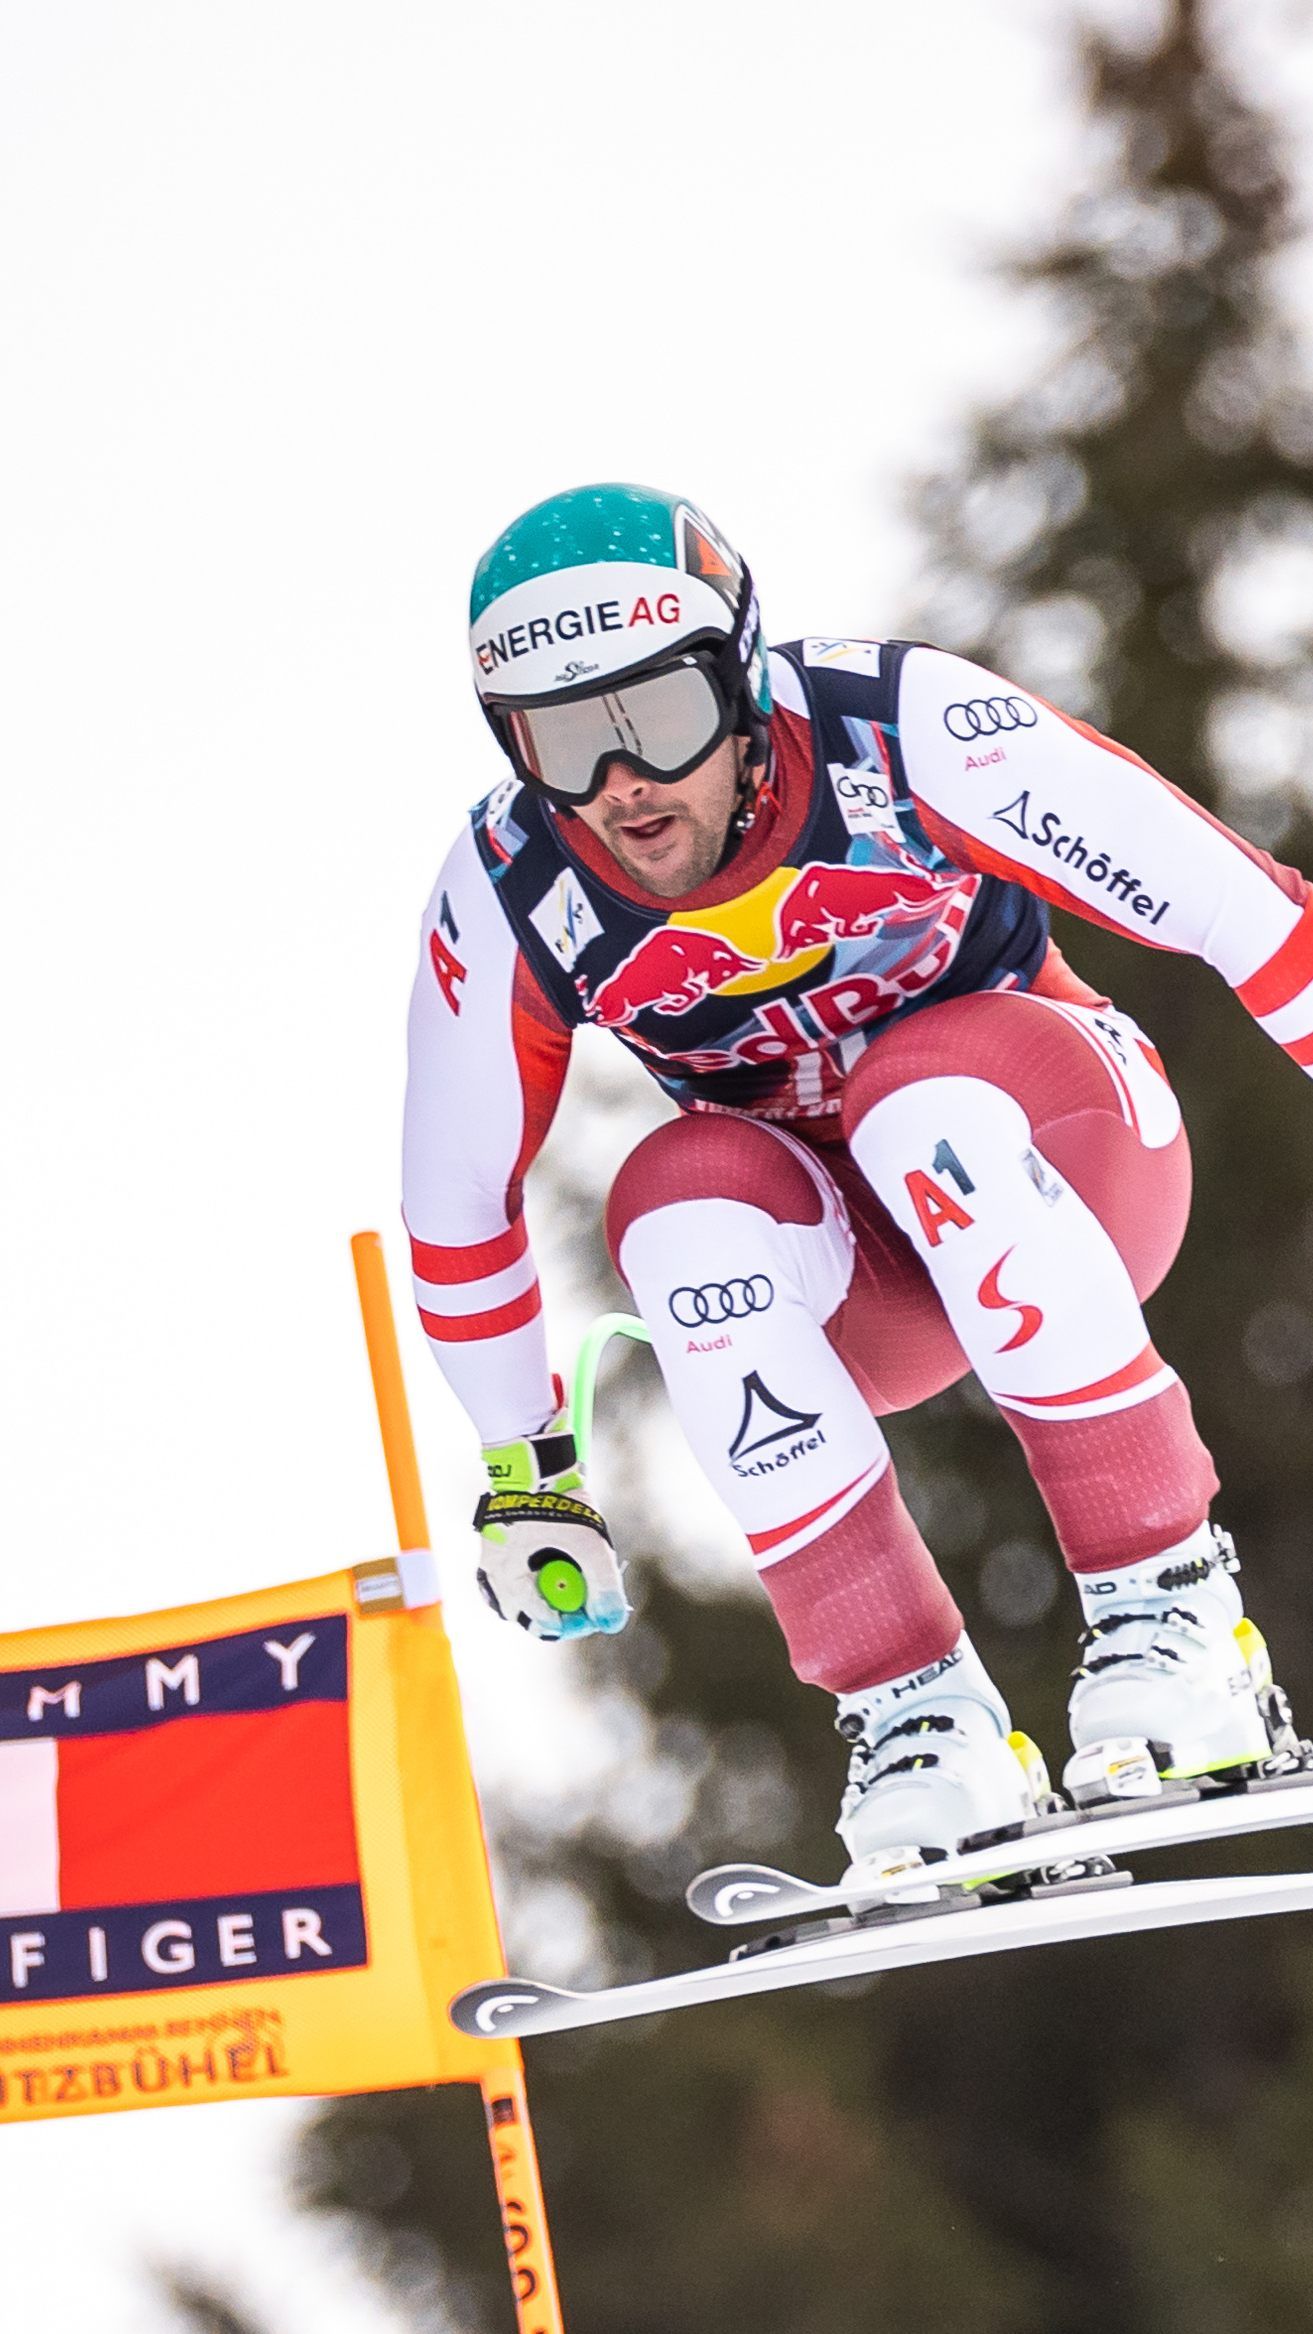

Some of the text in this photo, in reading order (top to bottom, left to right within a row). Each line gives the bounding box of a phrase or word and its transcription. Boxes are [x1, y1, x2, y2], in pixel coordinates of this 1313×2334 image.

[964, 747, 1007, 772] Audi
[1031, 812, 1171, 926] Schöffel
[904, 1138, 976, 1248] A1
[685, 1334, 732, 1355] Audi
[732, 1430, 827, 1478] Schöffel
[891, 1647, 964, 1699] HEAD
